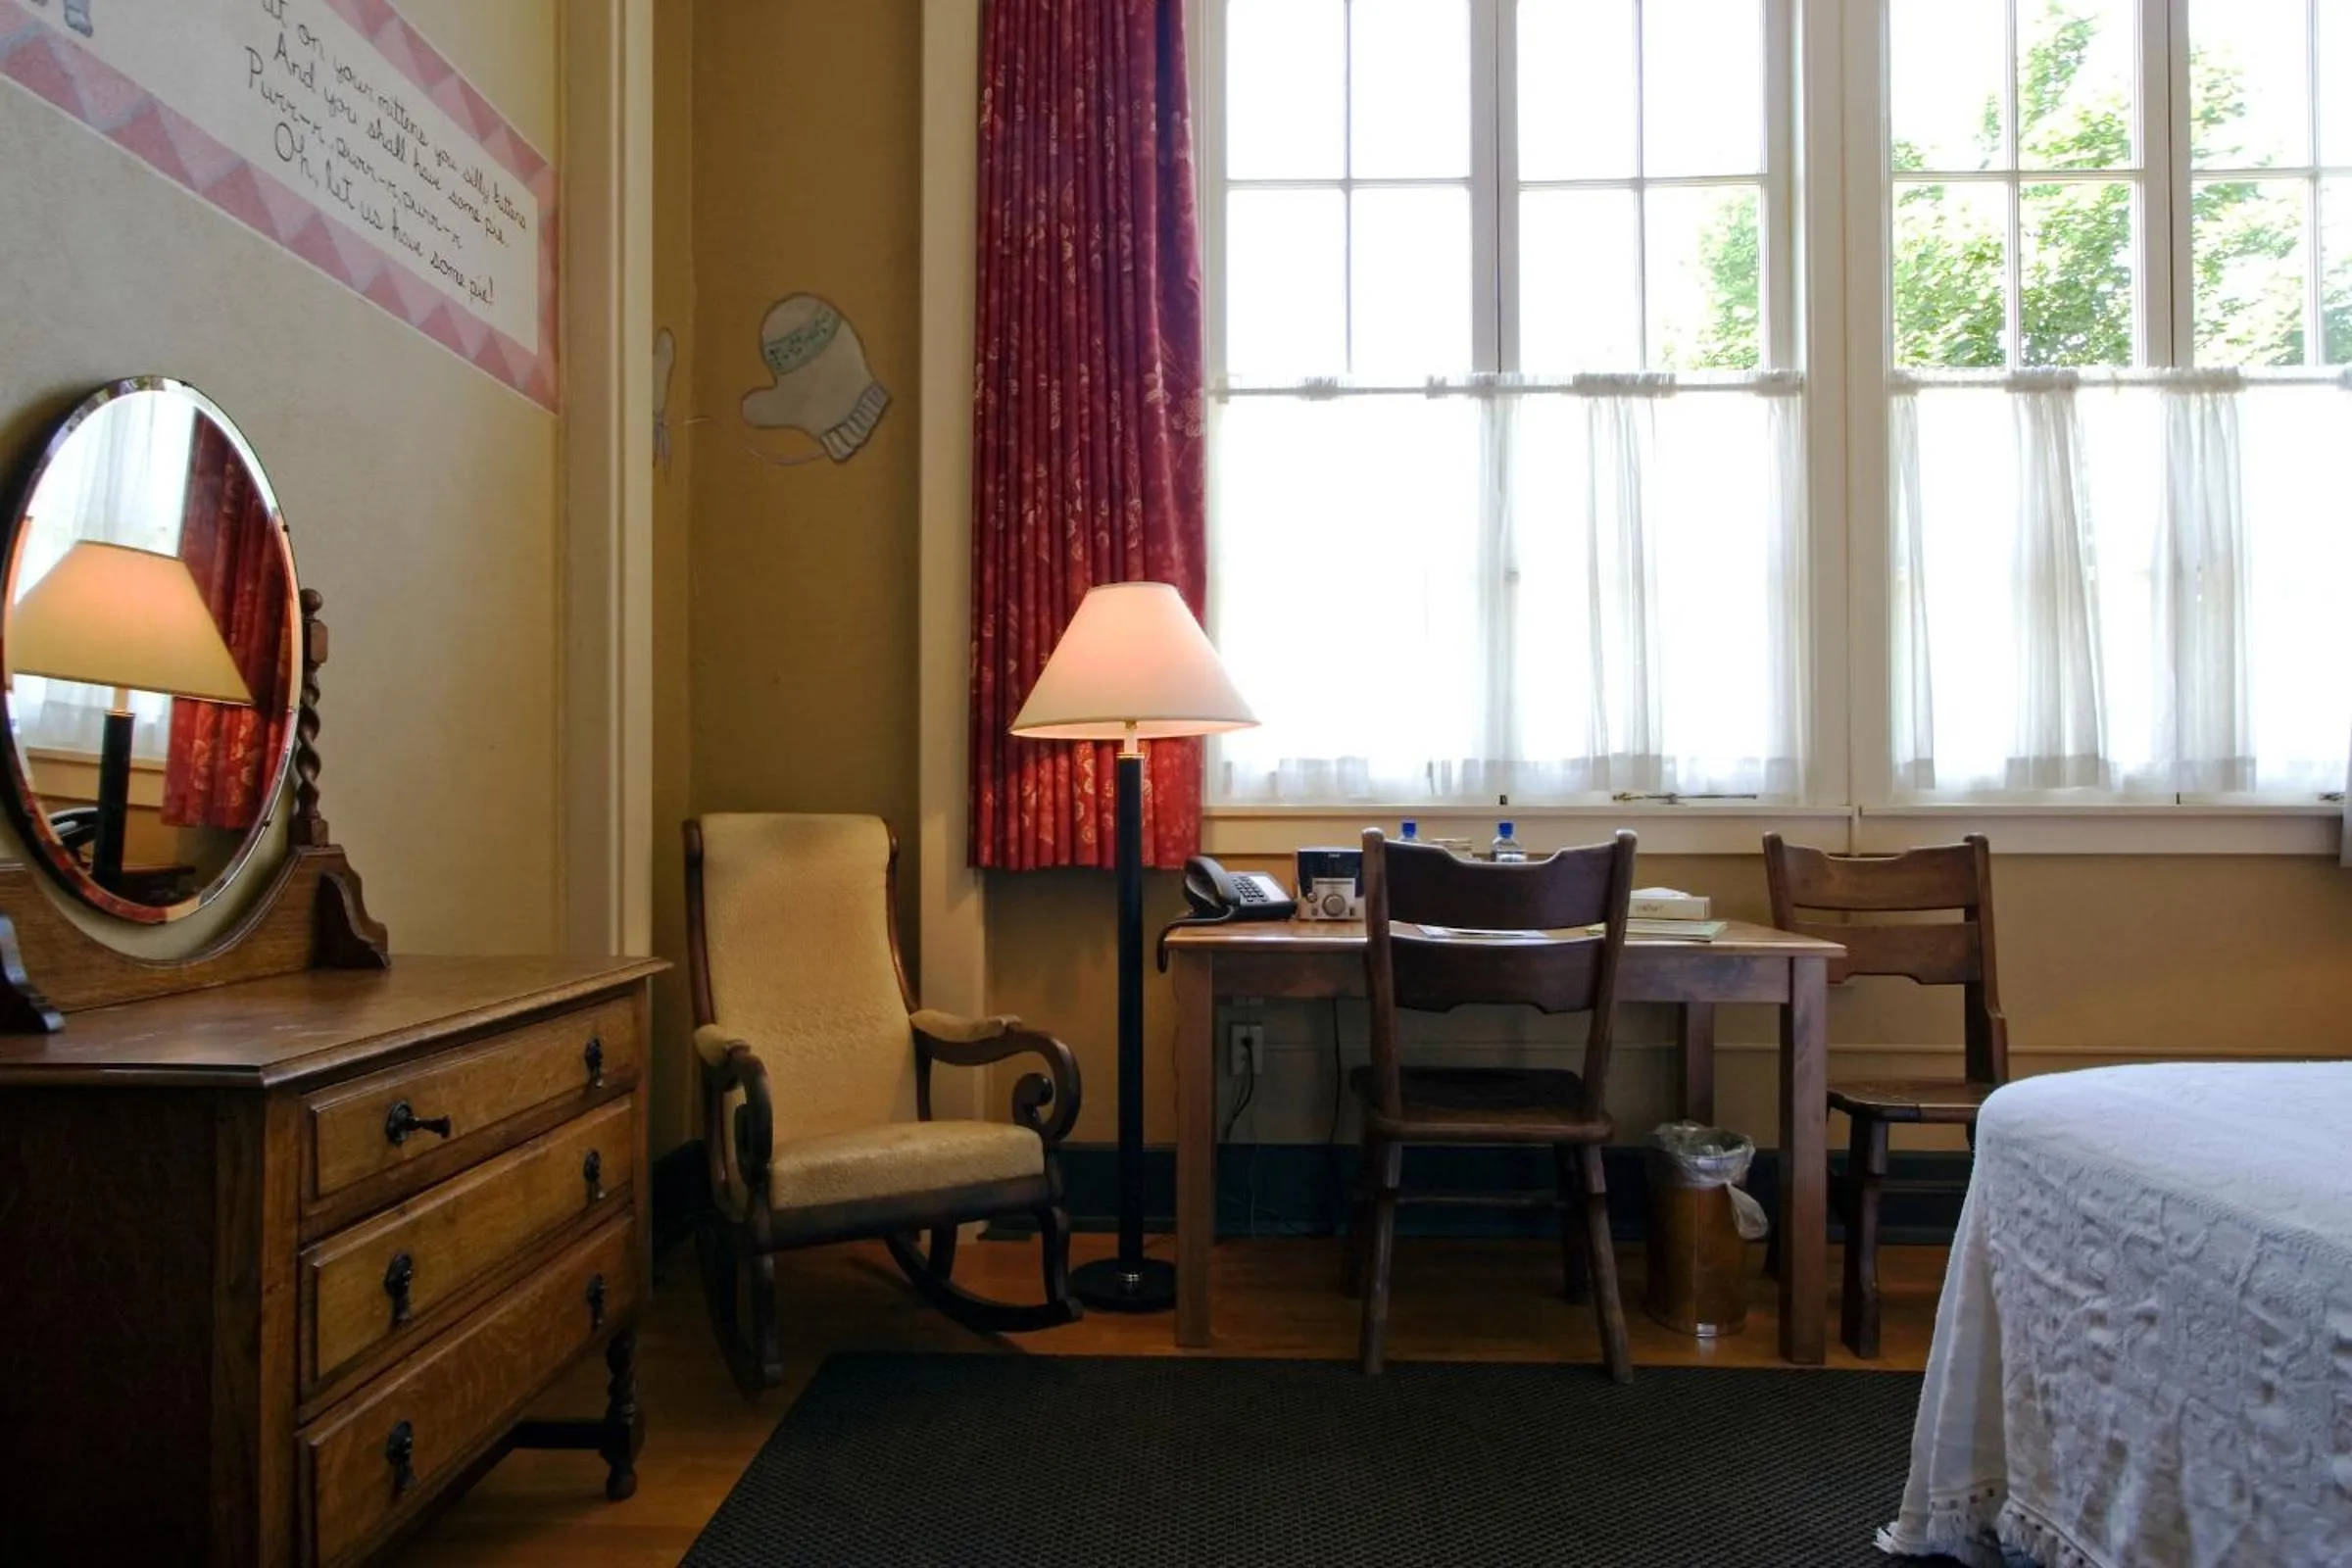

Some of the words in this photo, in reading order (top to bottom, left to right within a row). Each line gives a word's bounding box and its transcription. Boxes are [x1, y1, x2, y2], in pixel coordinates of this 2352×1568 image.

[273, 32, 315, 93] And
[323, 86, 358, 125] you
[366, 118, 406, 163] shall
[414, 147, 441, 190] have
[448, 190, 480, 222] some
[274, 122, 319, 187] Oh,
[325, 159, 355, 209] let
[360, 200, 384, 230] us
[392, 206, 422, 256] have
[431, 251, 466, 287] some
[469, 275, 494, 305] pie!
[298, 24, 324, 61] on
[333, 55, 373, 103] your
[377, 95, 428, 147] mittens
[434, 148, 457, 171] you
[463, 166, 489, 204] silly
[493, 181, 526, 229] kittens
